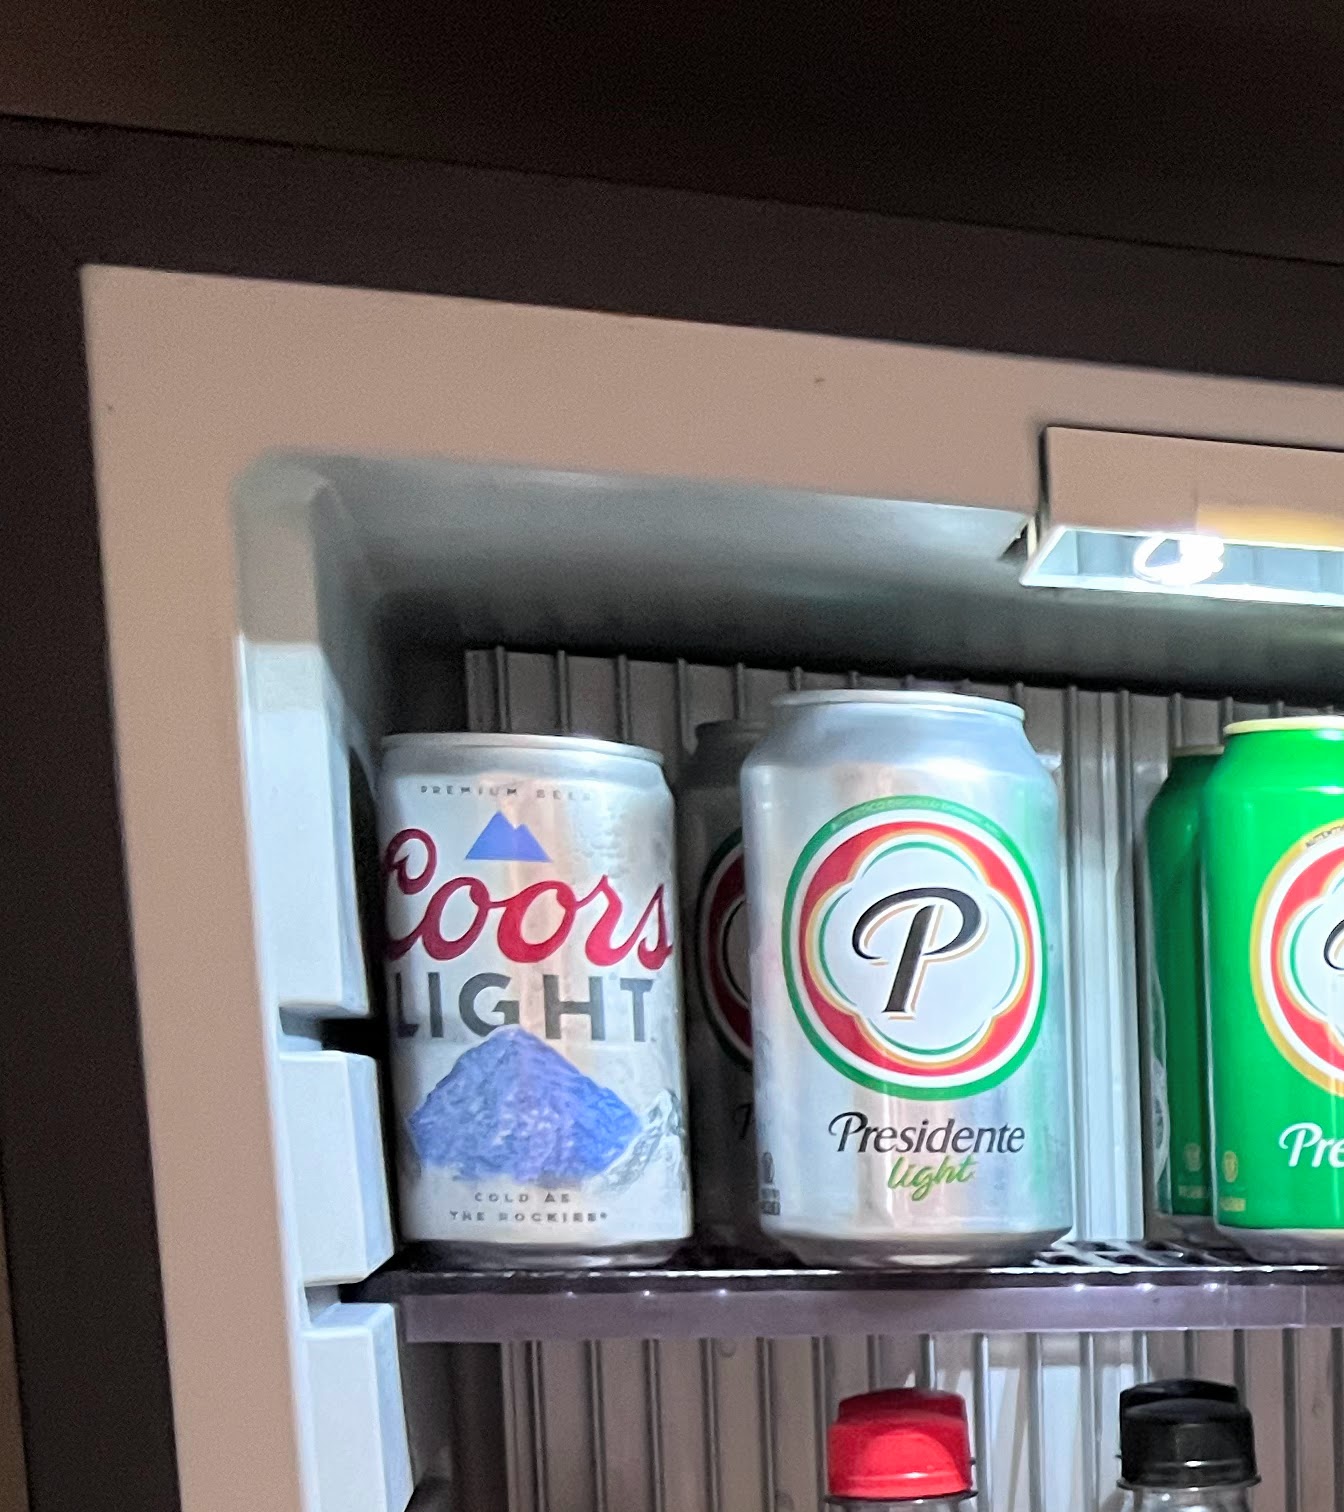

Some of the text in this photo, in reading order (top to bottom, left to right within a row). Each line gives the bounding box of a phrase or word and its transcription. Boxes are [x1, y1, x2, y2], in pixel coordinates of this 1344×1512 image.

[385, 828, 673, 971] Coors
[852, 886, 982, 1013] P
[395, 971, 654, 1043] LIGHT
[829, 1111, 1025, 1154] Presidente
[475, 1192, 570, 1203] COLD AS
[887, 1155, 975, 1202] light
[450, 1210, 485, 1222] THE
